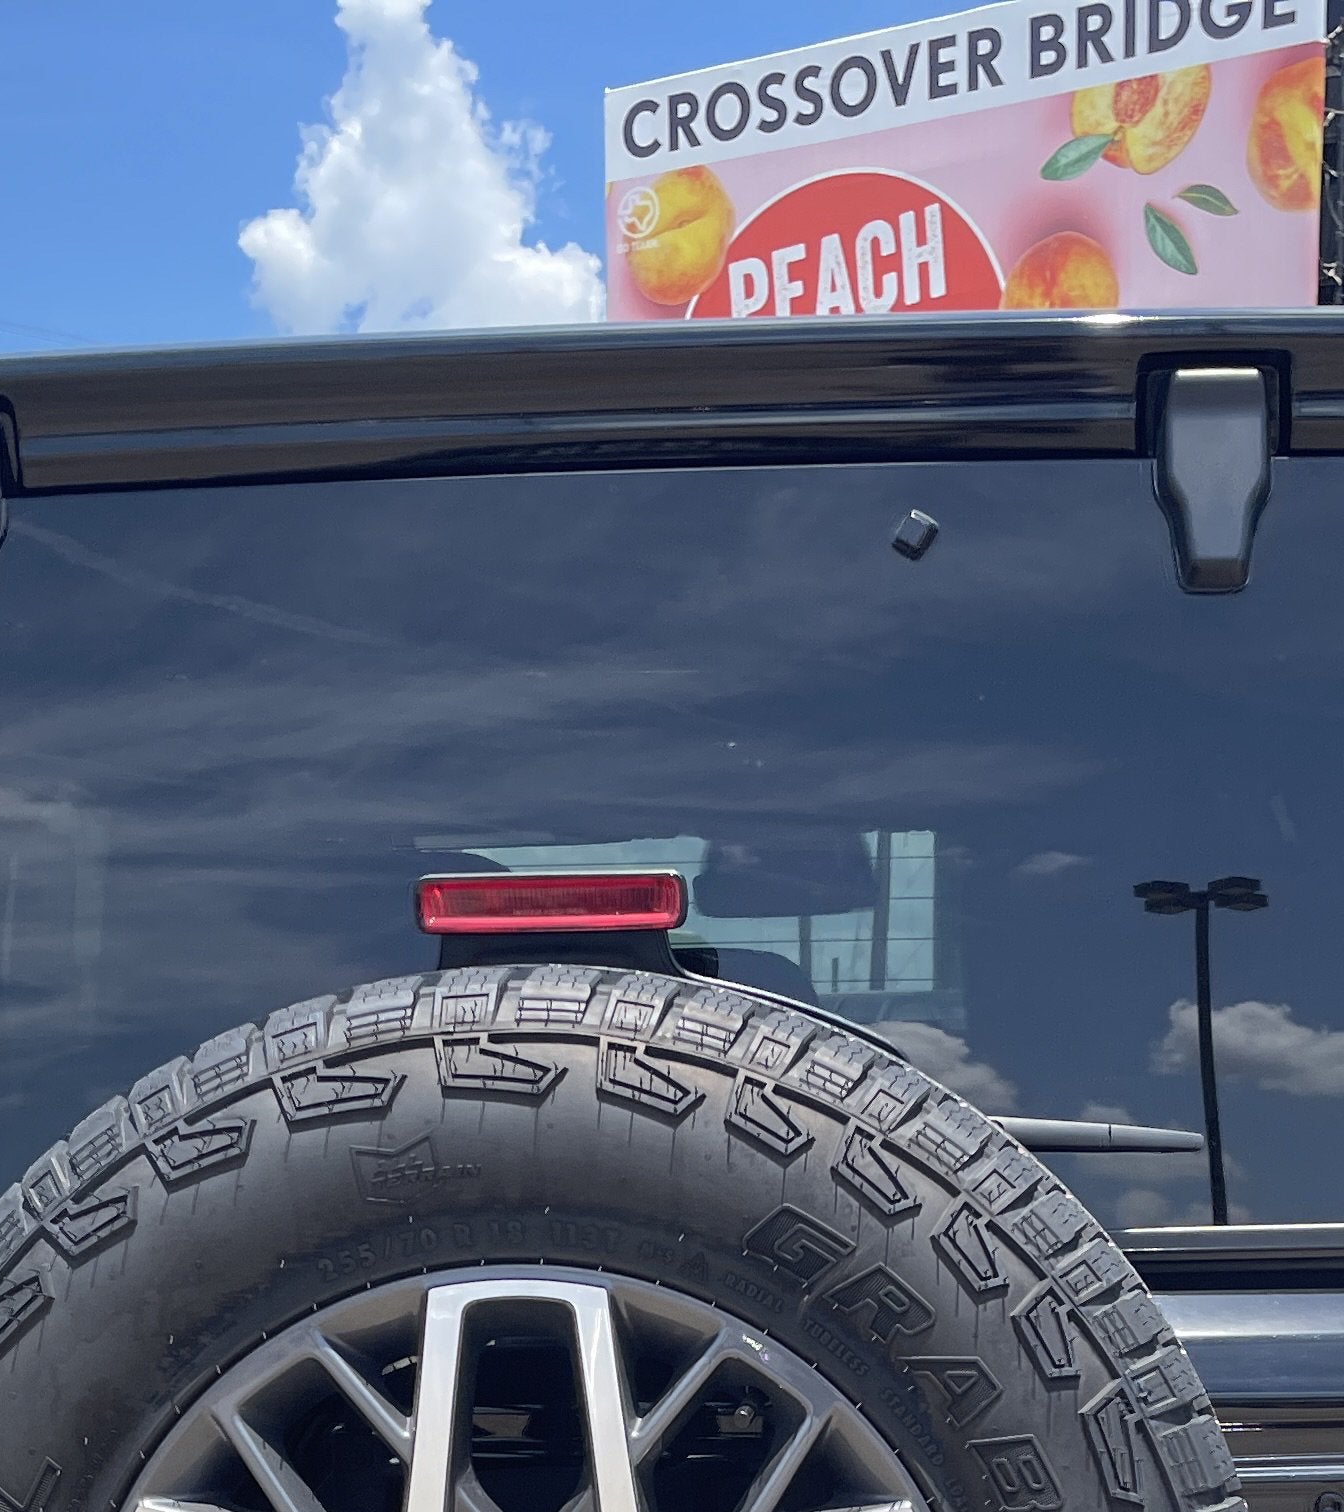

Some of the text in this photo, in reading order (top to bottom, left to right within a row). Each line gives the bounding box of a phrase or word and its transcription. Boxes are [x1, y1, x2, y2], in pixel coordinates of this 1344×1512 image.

[622, 31, 1003, 159] CROSSOVER
[728, 202, 947, 318] PEACH
[722, 1272, 786, 1315] RADIAL
[799, 1315, 872, 1380] TUBELESS
